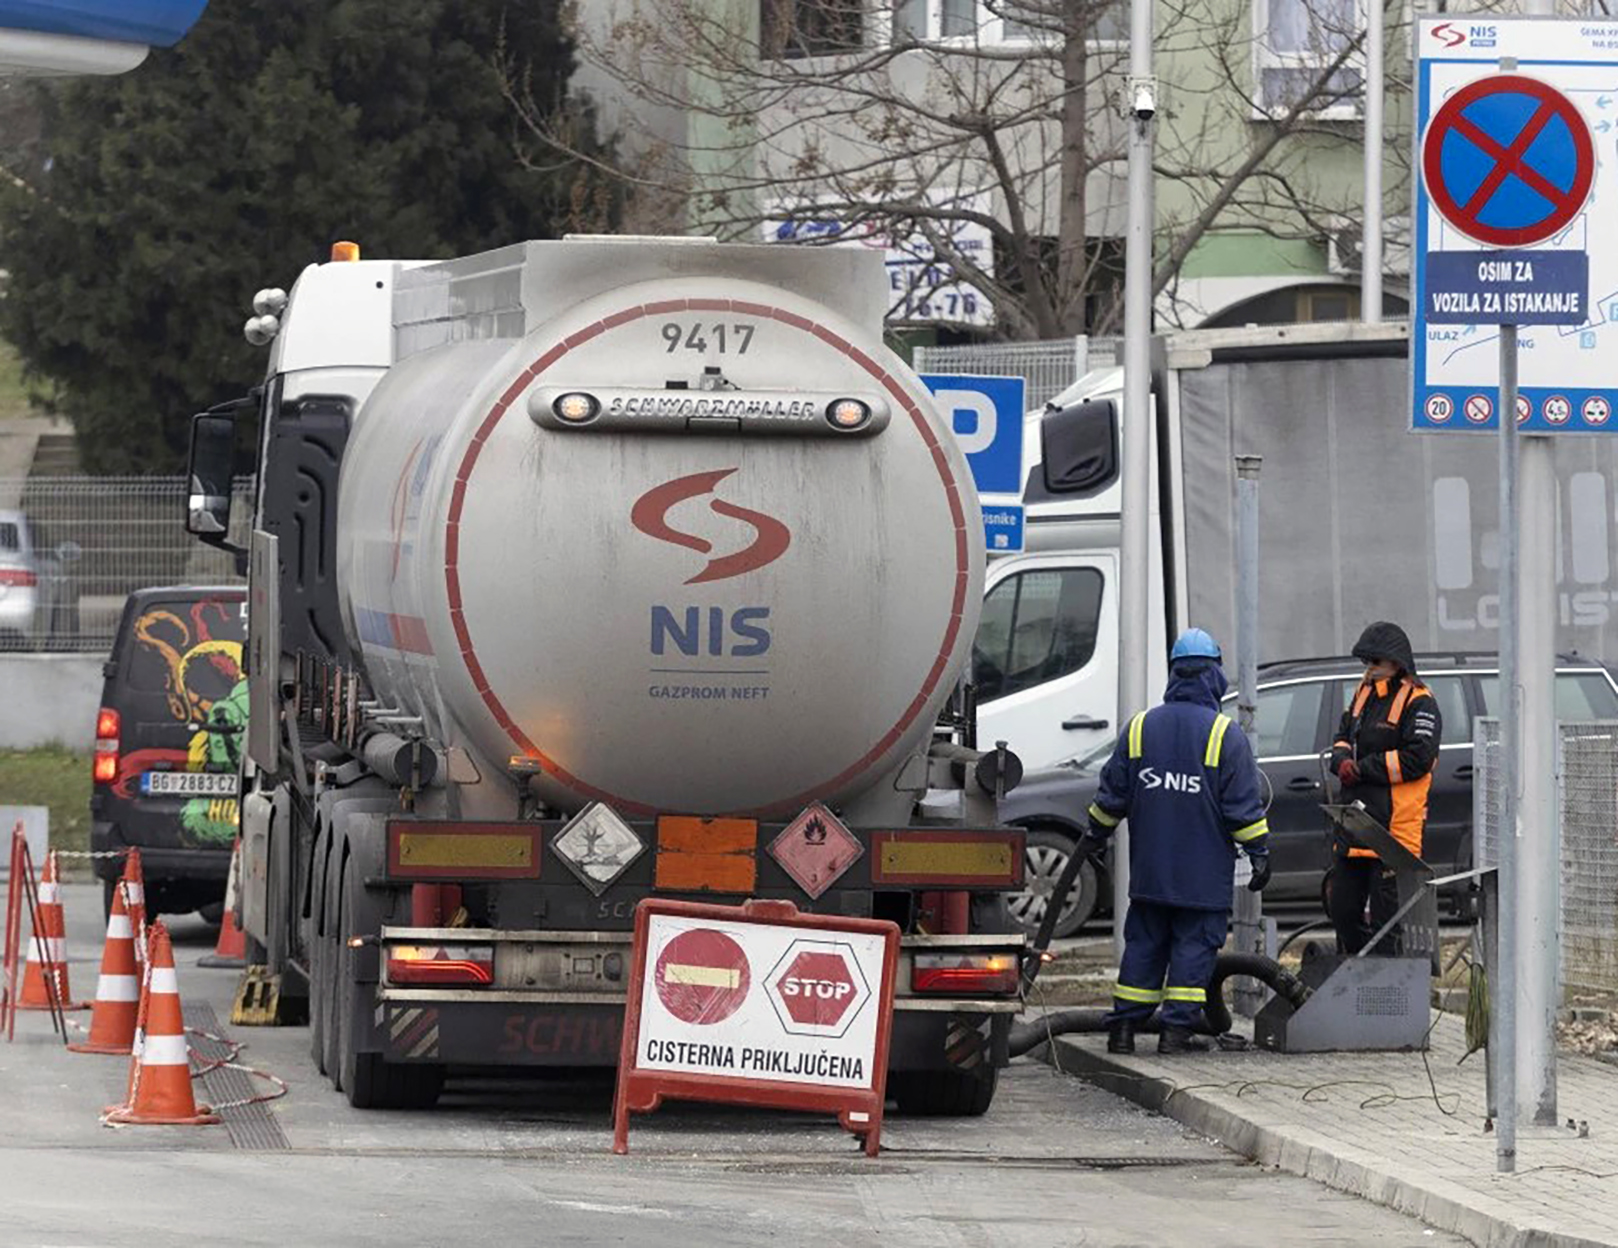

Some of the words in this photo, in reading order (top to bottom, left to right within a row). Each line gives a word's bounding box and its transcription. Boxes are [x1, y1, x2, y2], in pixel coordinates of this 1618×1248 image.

[1470, 26, 1497, 37] NIS
[1478, 262, 1512, 281] OSIM
[1515, 262, 1533, 281] ZA
[1433, 293, 1480, 312] VOZILA
[1483, 293, 1502, 312] ZA
[1505, 293, 1579, 312] ISTAKANJE
[661, 323, 755, 354] 9417
[1428, 331, 1459, 341] ULAZ
[1516, 339, 1535, 349] NG
[610, 398, 815, 420] SCHWARZMÜLLER
[1431, 400, 1447, 416] 20
[934, 389, 997, 454] P
[983, 511, 1017, 526] risnike
[651, 605, 771, 657] NIS
[649, 685, 726, 700] GAZPROM
[731, 687, 770, 700] NEFT
[151, 773, 170, 791] BG
[1164, 771, 1201, 794] NIS
[783, 977, 851, 1001] STOP
[646, 1039, 735, 1069] CISTERNA
[740, 1047, 864, 1081] PRIKLJUČENA
